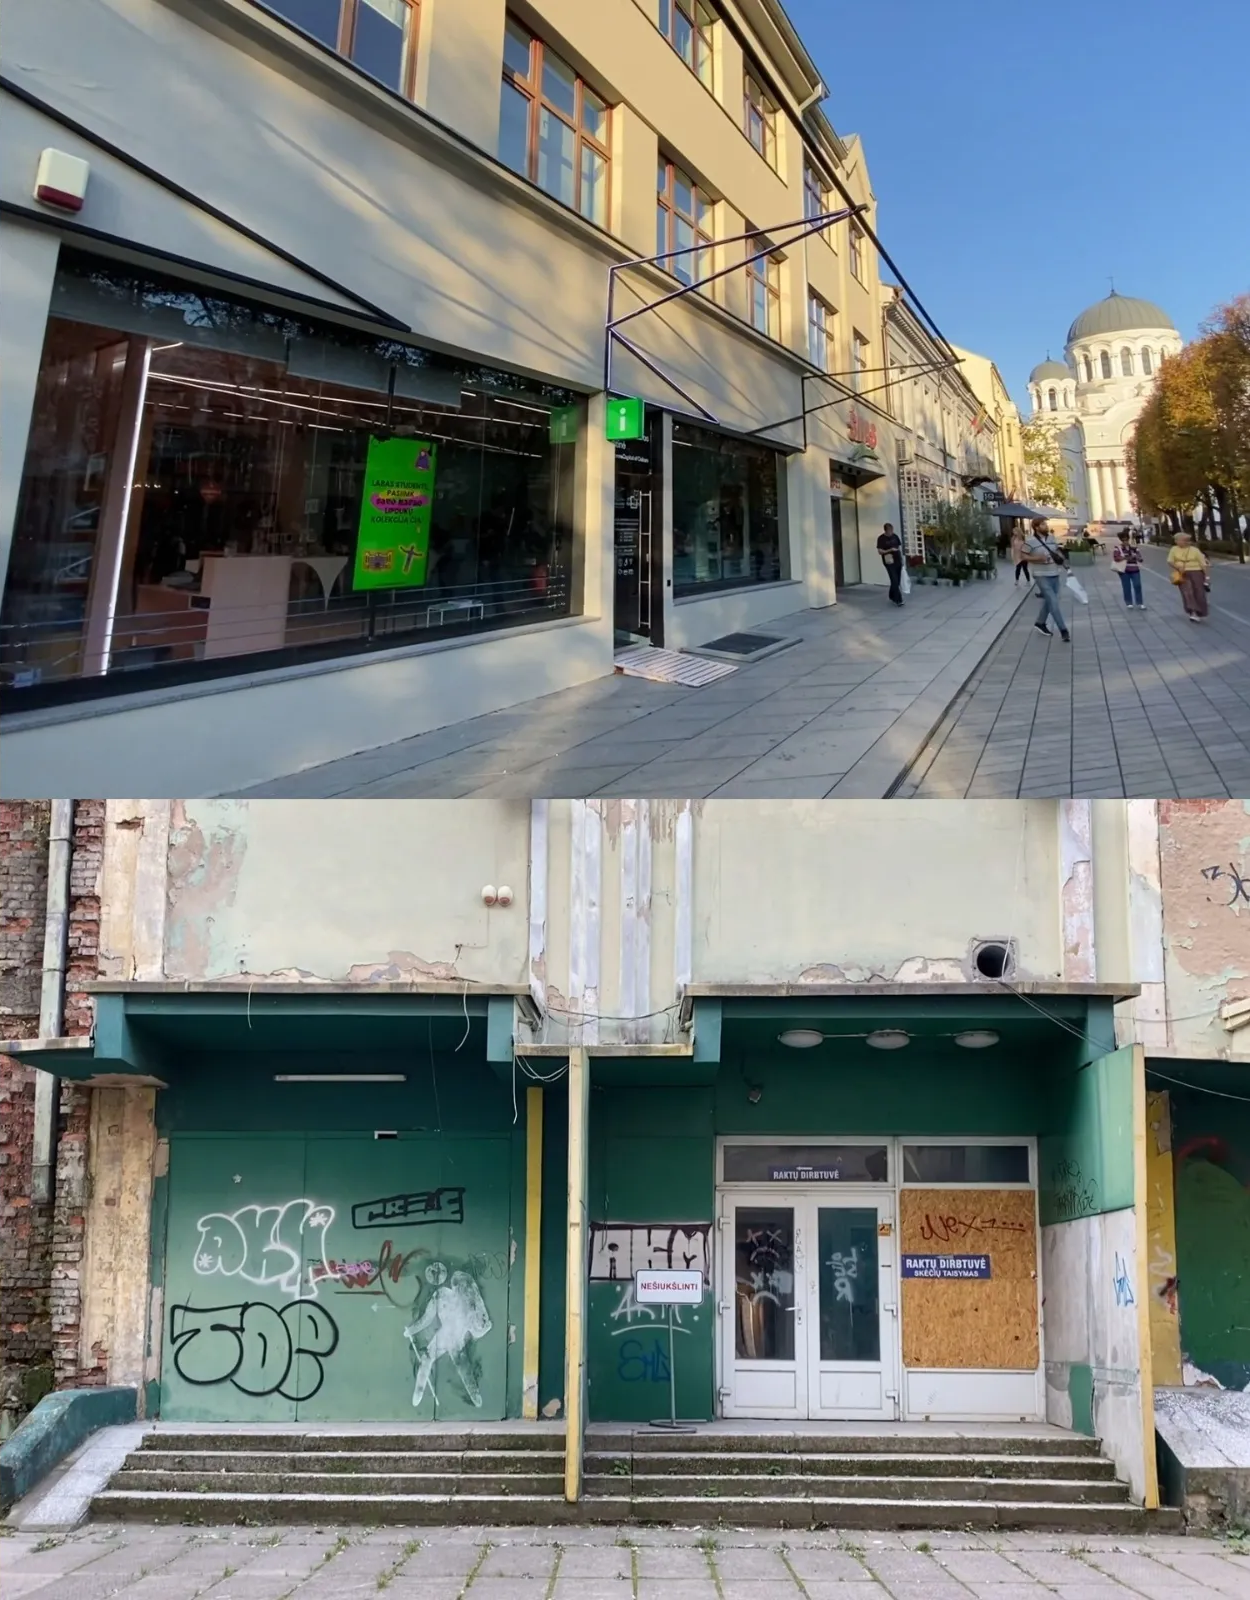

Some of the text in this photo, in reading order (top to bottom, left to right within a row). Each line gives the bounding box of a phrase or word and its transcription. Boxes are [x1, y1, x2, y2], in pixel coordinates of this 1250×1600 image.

[773, 1170, 840, 1181] RAKTŲ DIRBTUVĖ
[906, 1258, 986, 1270] RAKTŲ DIRBTUVĖ
[640, 1281, 698, 1291] NEŠIUKŠLINTI
